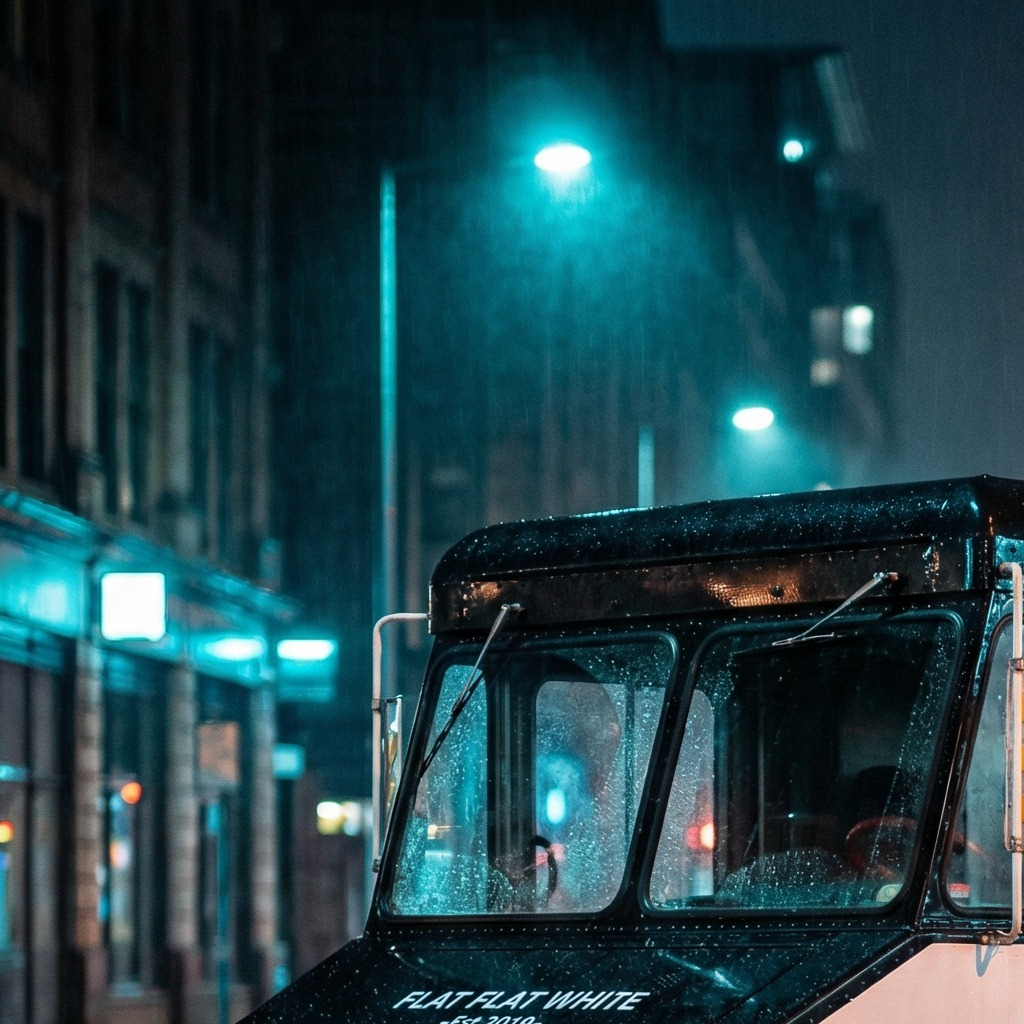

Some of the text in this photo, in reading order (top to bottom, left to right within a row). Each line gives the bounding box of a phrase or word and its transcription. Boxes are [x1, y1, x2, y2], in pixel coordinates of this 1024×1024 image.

[392, 990, 651, 1011] FLAT FLAT WHITE
